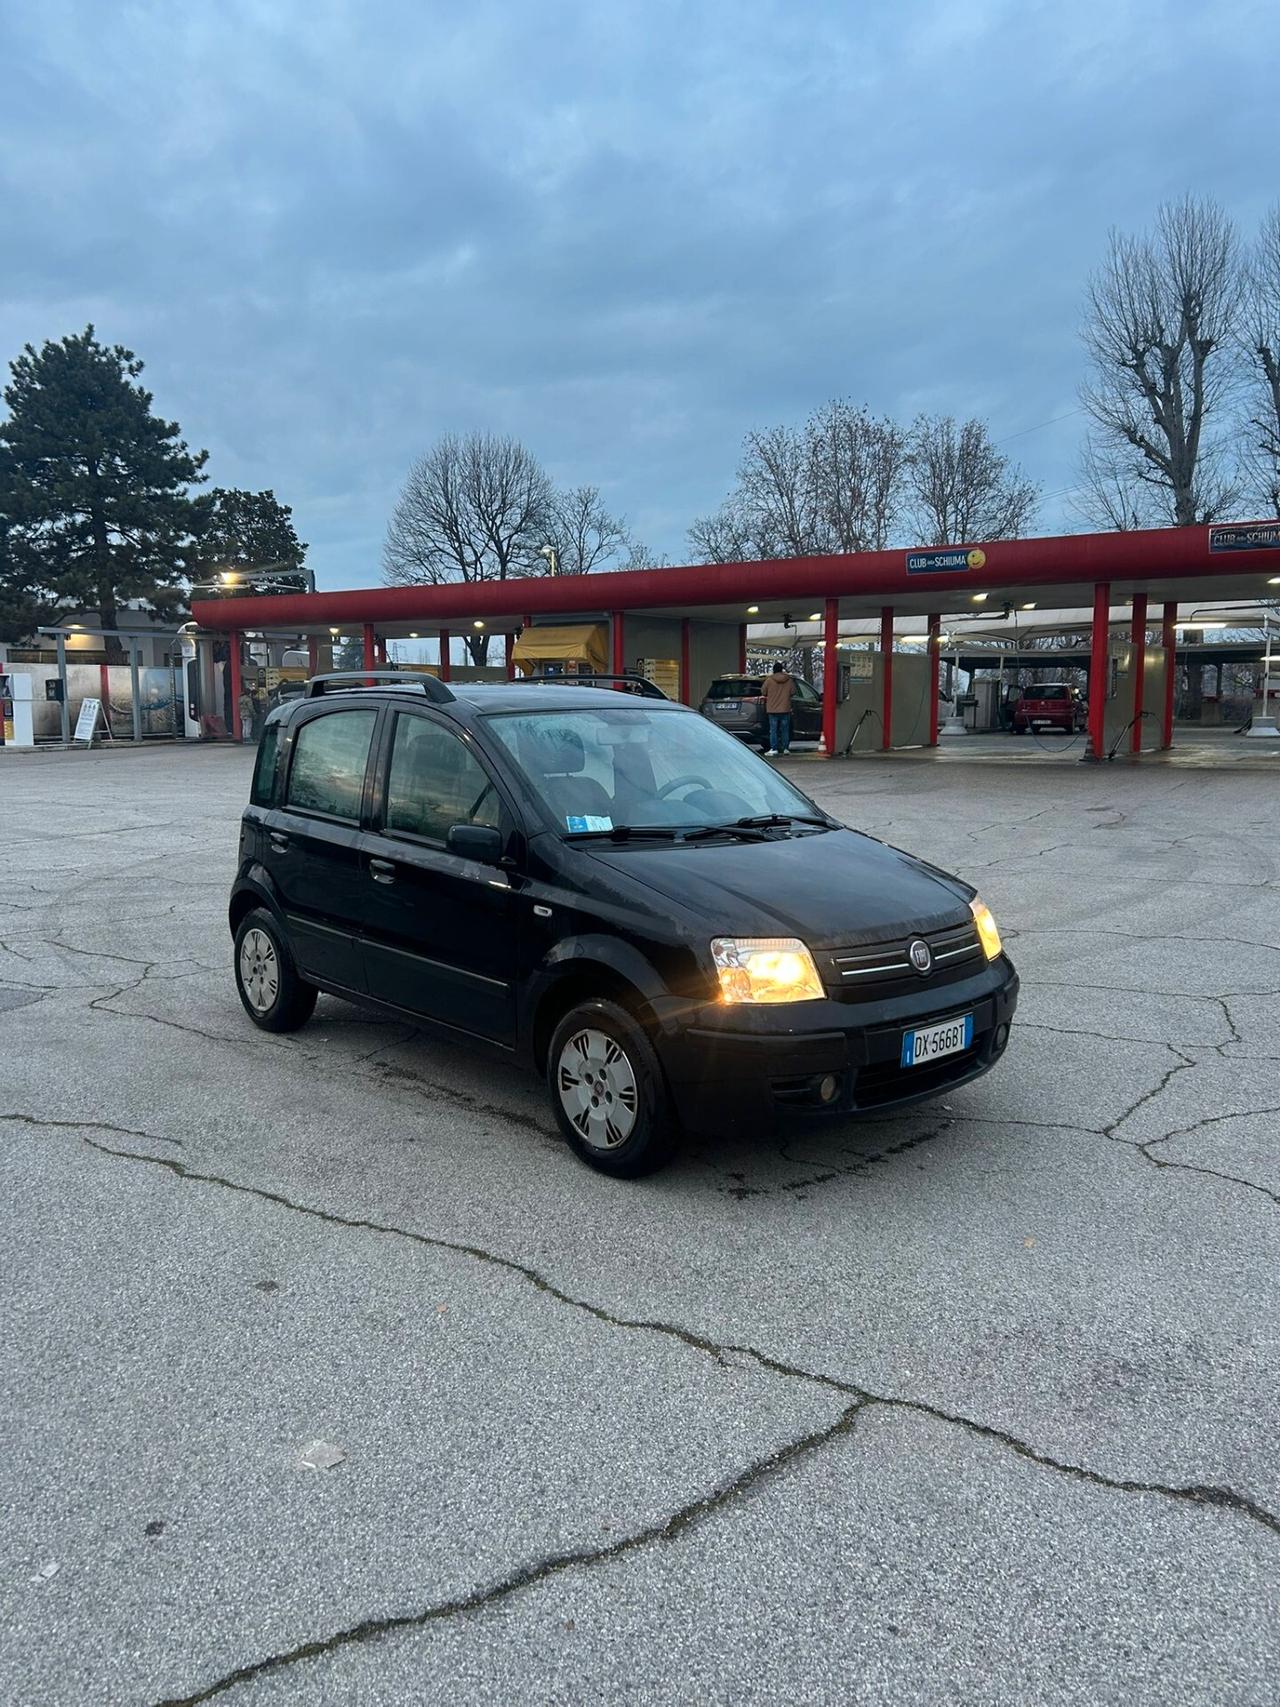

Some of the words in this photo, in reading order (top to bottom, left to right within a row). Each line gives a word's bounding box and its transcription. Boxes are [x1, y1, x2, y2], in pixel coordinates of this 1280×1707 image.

[1214, 533, 1236, 546] CLUB
[909, 557, 926, 569] CLUB
[934, 555, 967, 567] SCHIUMA
[915, 1034, 929, 1058] DX
[931, 1024, 964, 1053] 566BT
